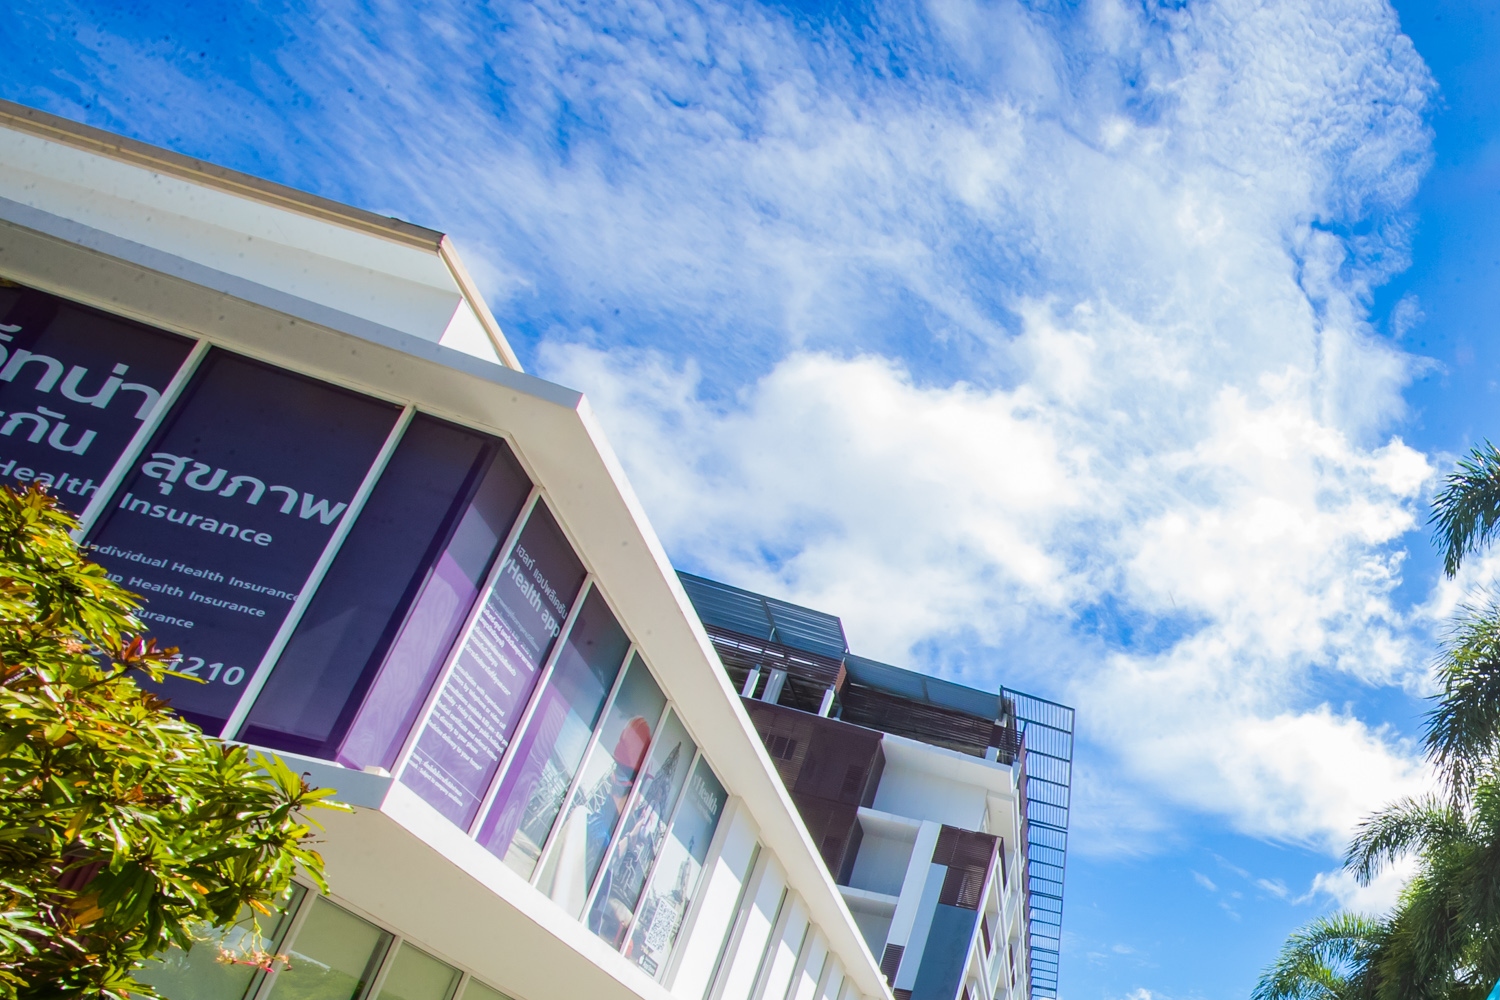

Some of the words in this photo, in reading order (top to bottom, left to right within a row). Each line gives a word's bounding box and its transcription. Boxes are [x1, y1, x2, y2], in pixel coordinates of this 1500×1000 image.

[142, 452, 348, 526] สุขภาพ
[119, 492, 273, 547] Insurance
[171, 561, 225, 583] Health
[128, 576, 184, 598] Health
[189, 591, 266, 618] Insurance
[541, 609, 561, 638] app
